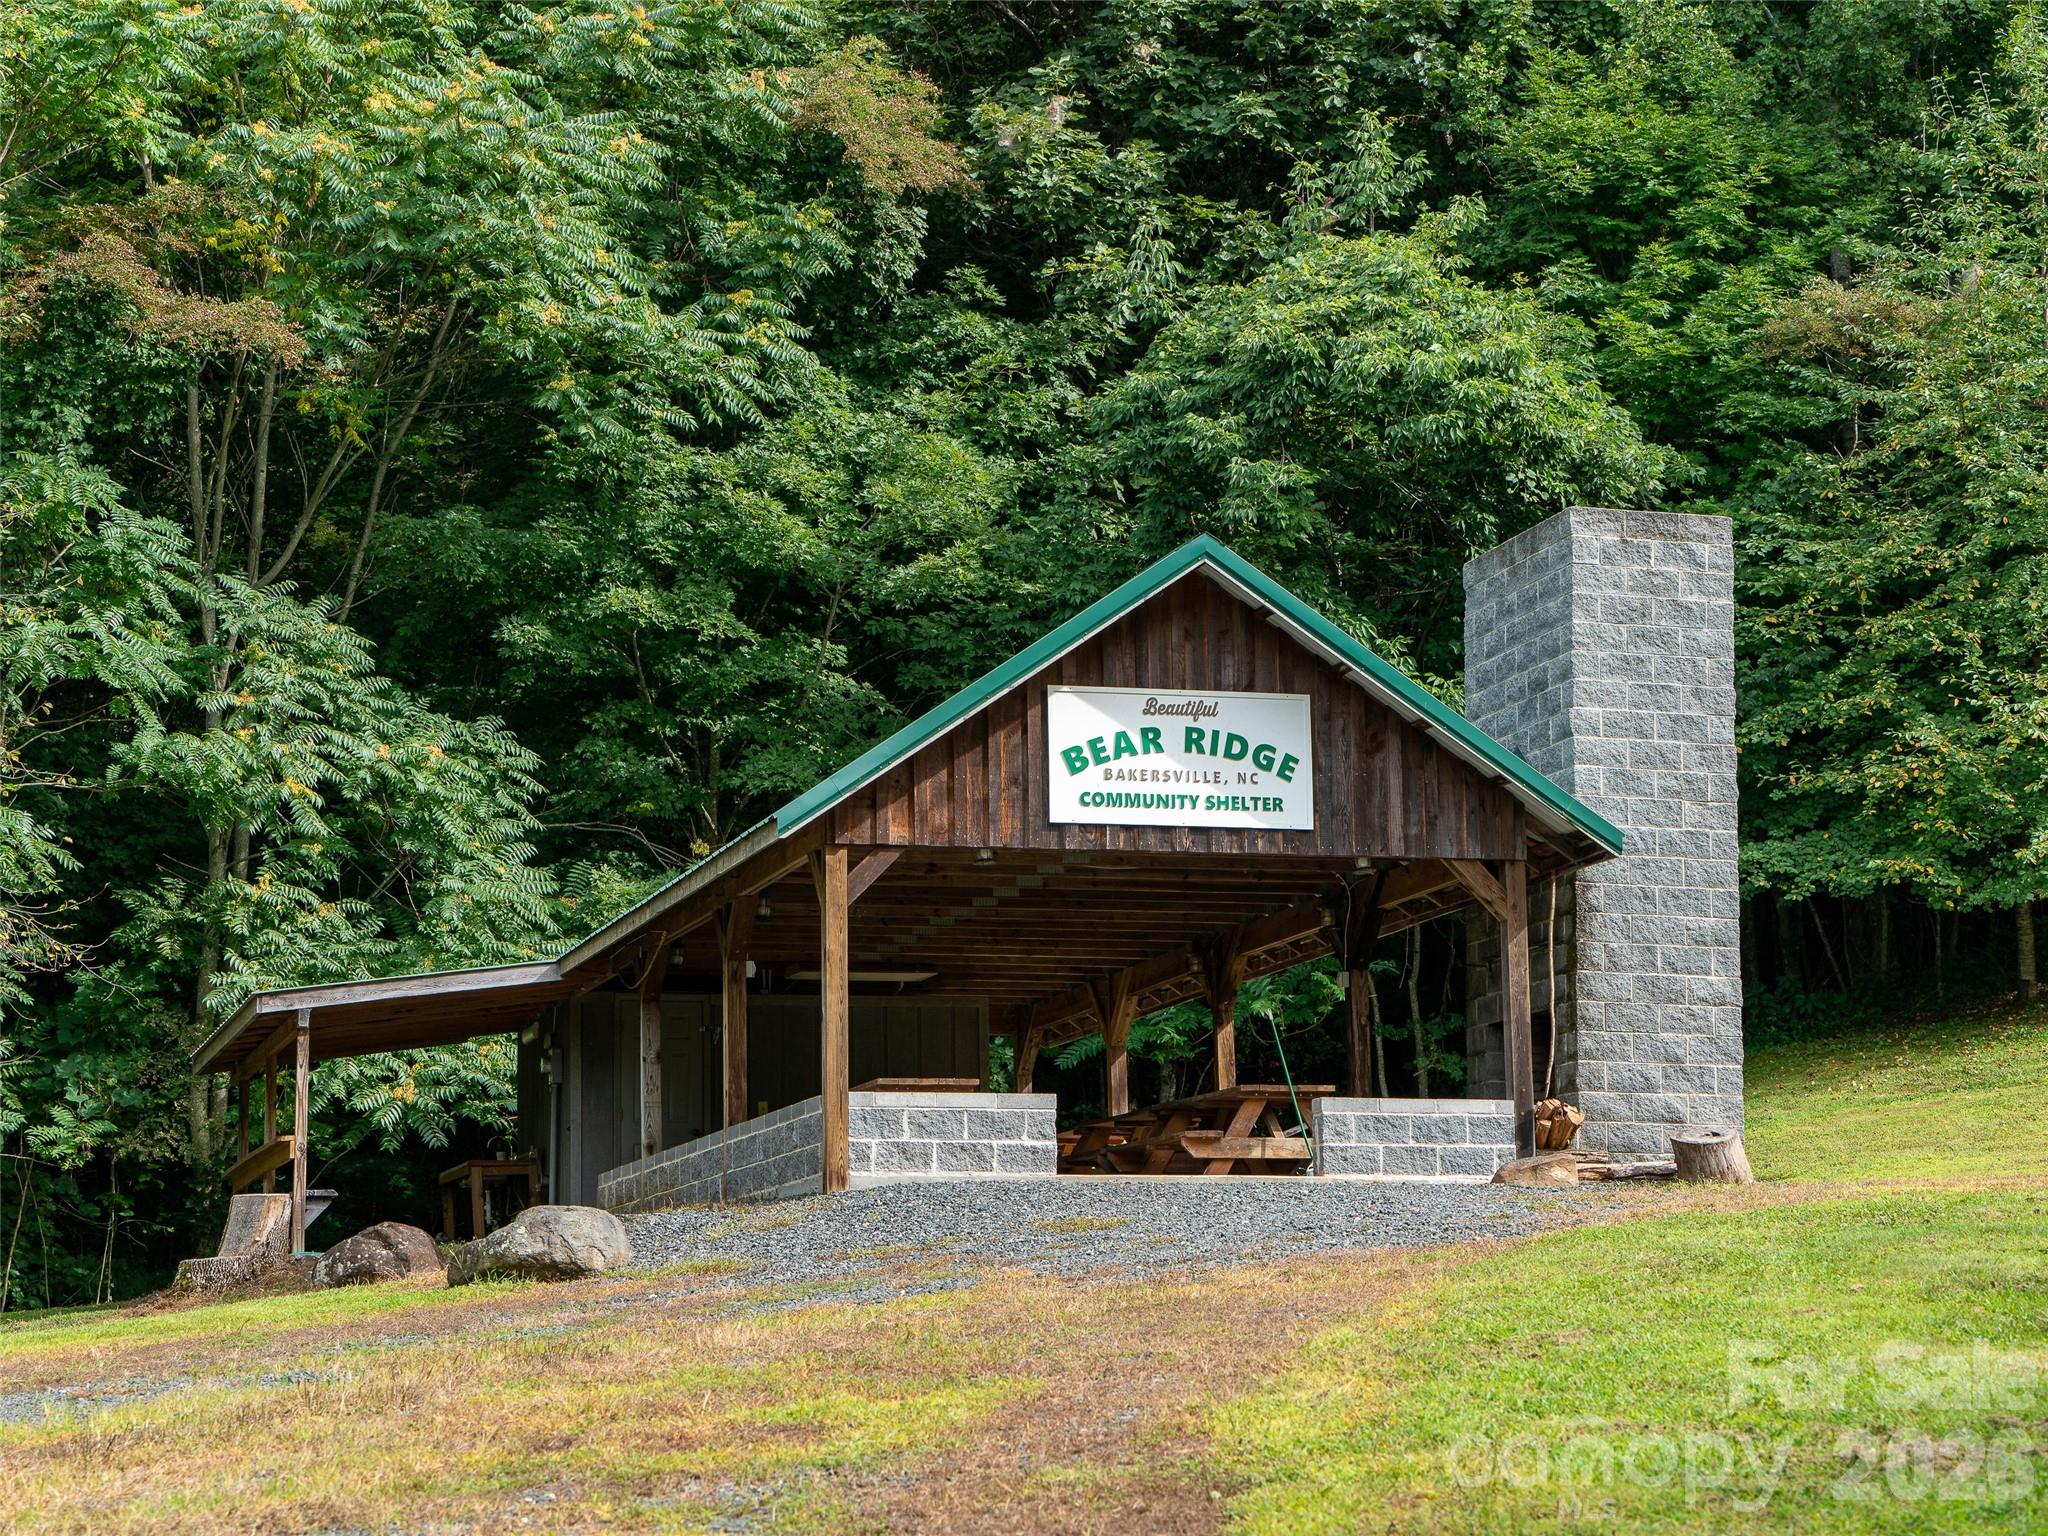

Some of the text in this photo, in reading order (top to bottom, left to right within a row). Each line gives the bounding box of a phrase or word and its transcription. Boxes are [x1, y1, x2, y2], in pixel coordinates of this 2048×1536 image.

[1142, 697, 1219, 721] Beautiful
[1060, 726, 1300, 783] BEAR RIDGE
[1103, 767, 1259, 786] BAKERSVILLE, NC
[1079, 791, 1284, 812] COMMUNITY SHELTER
